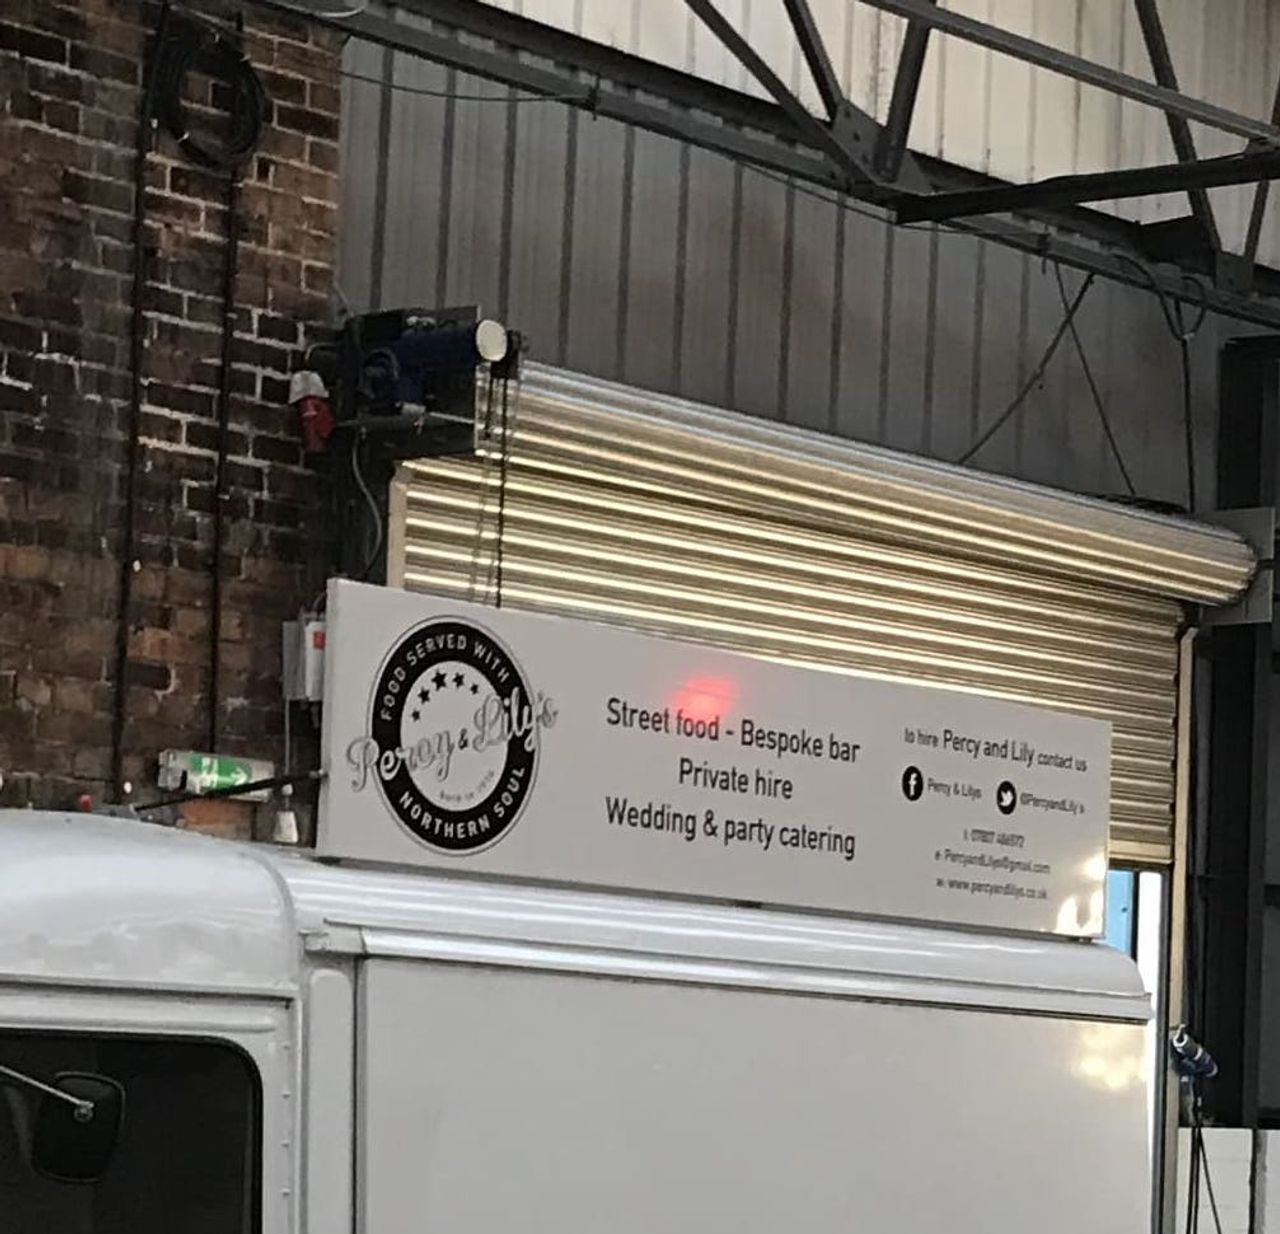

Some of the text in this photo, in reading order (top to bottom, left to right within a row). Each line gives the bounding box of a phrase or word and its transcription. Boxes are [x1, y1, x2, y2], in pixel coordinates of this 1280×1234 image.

[381, 633, 511, 721] FOOD SERVED WITH
[346, 730, 454, 792] Percy
[458, 728, 468, 750] &
[606, 697, 670, 734] Street
[676, 708, 720, 742] food
[741, 718, 824, 759] Bespoke
[829, 733, 861, 763] bar
[917, 728, 939, 748] hire
[943, 728, 981, 759] Percy
[983, 739, 1009, 759] and
[1012, 740, 1035, 768] Lily
[1037, 751, 1073, 770] contact
[1075, 758, 1088, 772] us
[400, 791, 491, 839] NORTHERN
[493, 767, 526, 818] SOUL
[679, 756, 794, 800] Private hire
[605, 795, 856, 862] Wedding & party catering
